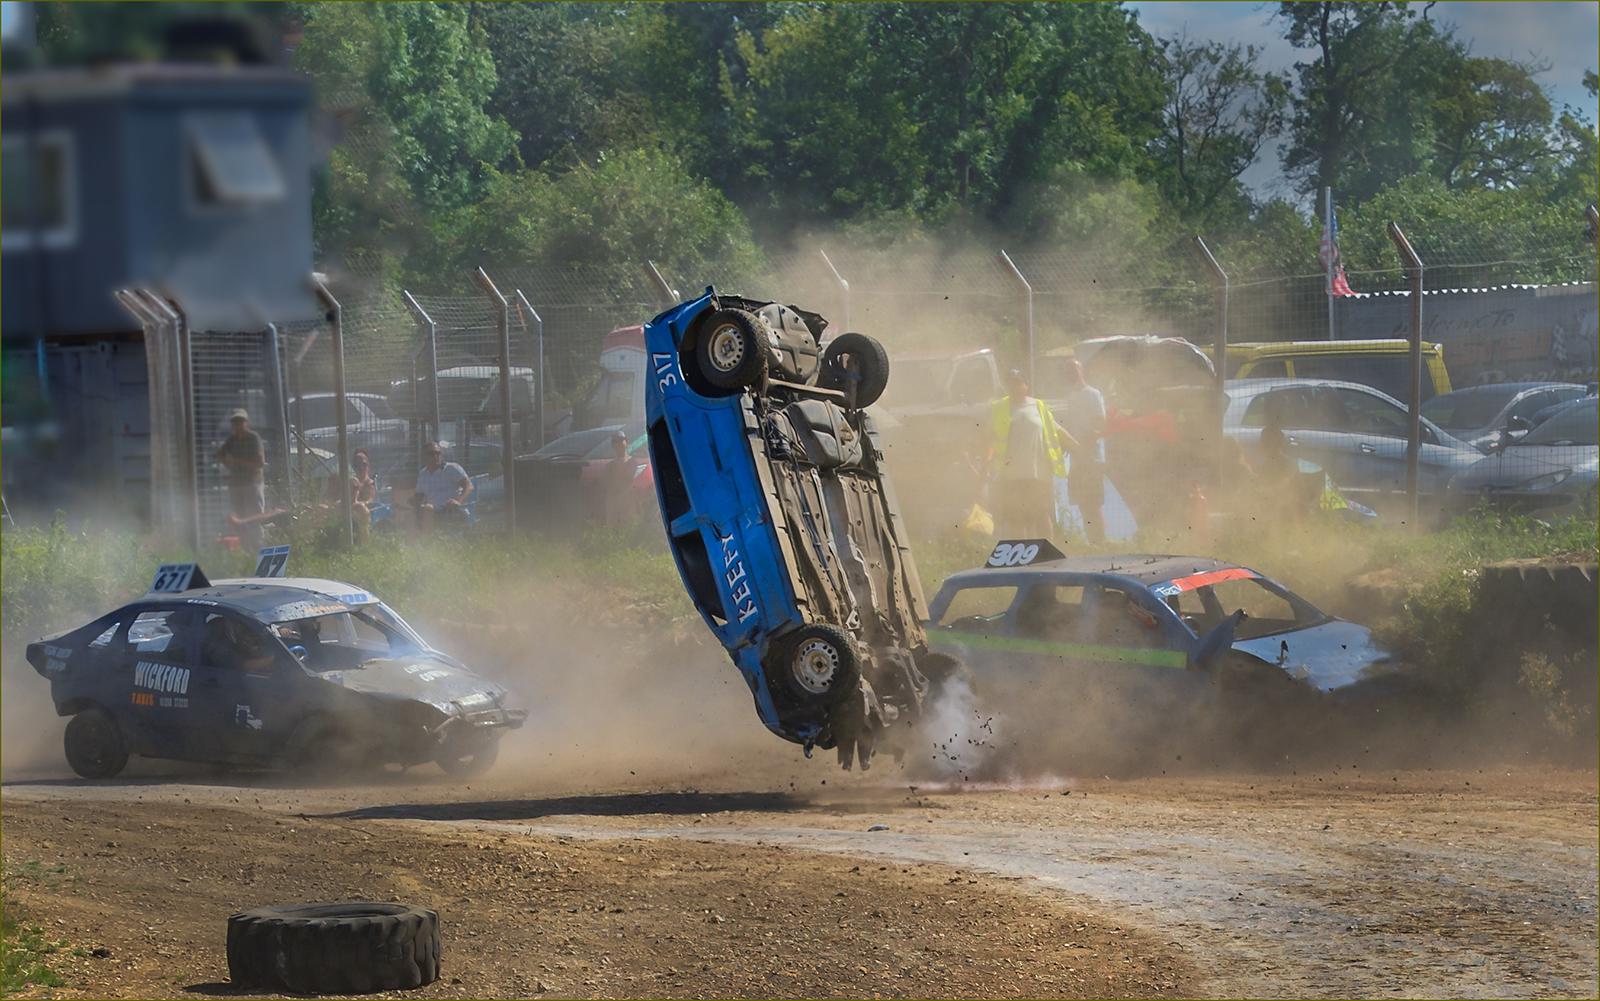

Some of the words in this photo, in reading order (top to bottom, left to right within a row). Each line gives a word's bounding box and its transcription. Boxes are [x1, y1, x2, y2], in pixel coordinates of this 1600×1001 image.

[652, 353, 677, 394] 317
[988, 543, 1039, 566] 309
[154, 571, 189, 591] 671
[721, 533, 758, 624] KEEFY
[134, 661, 190, 695] WICKFORD
